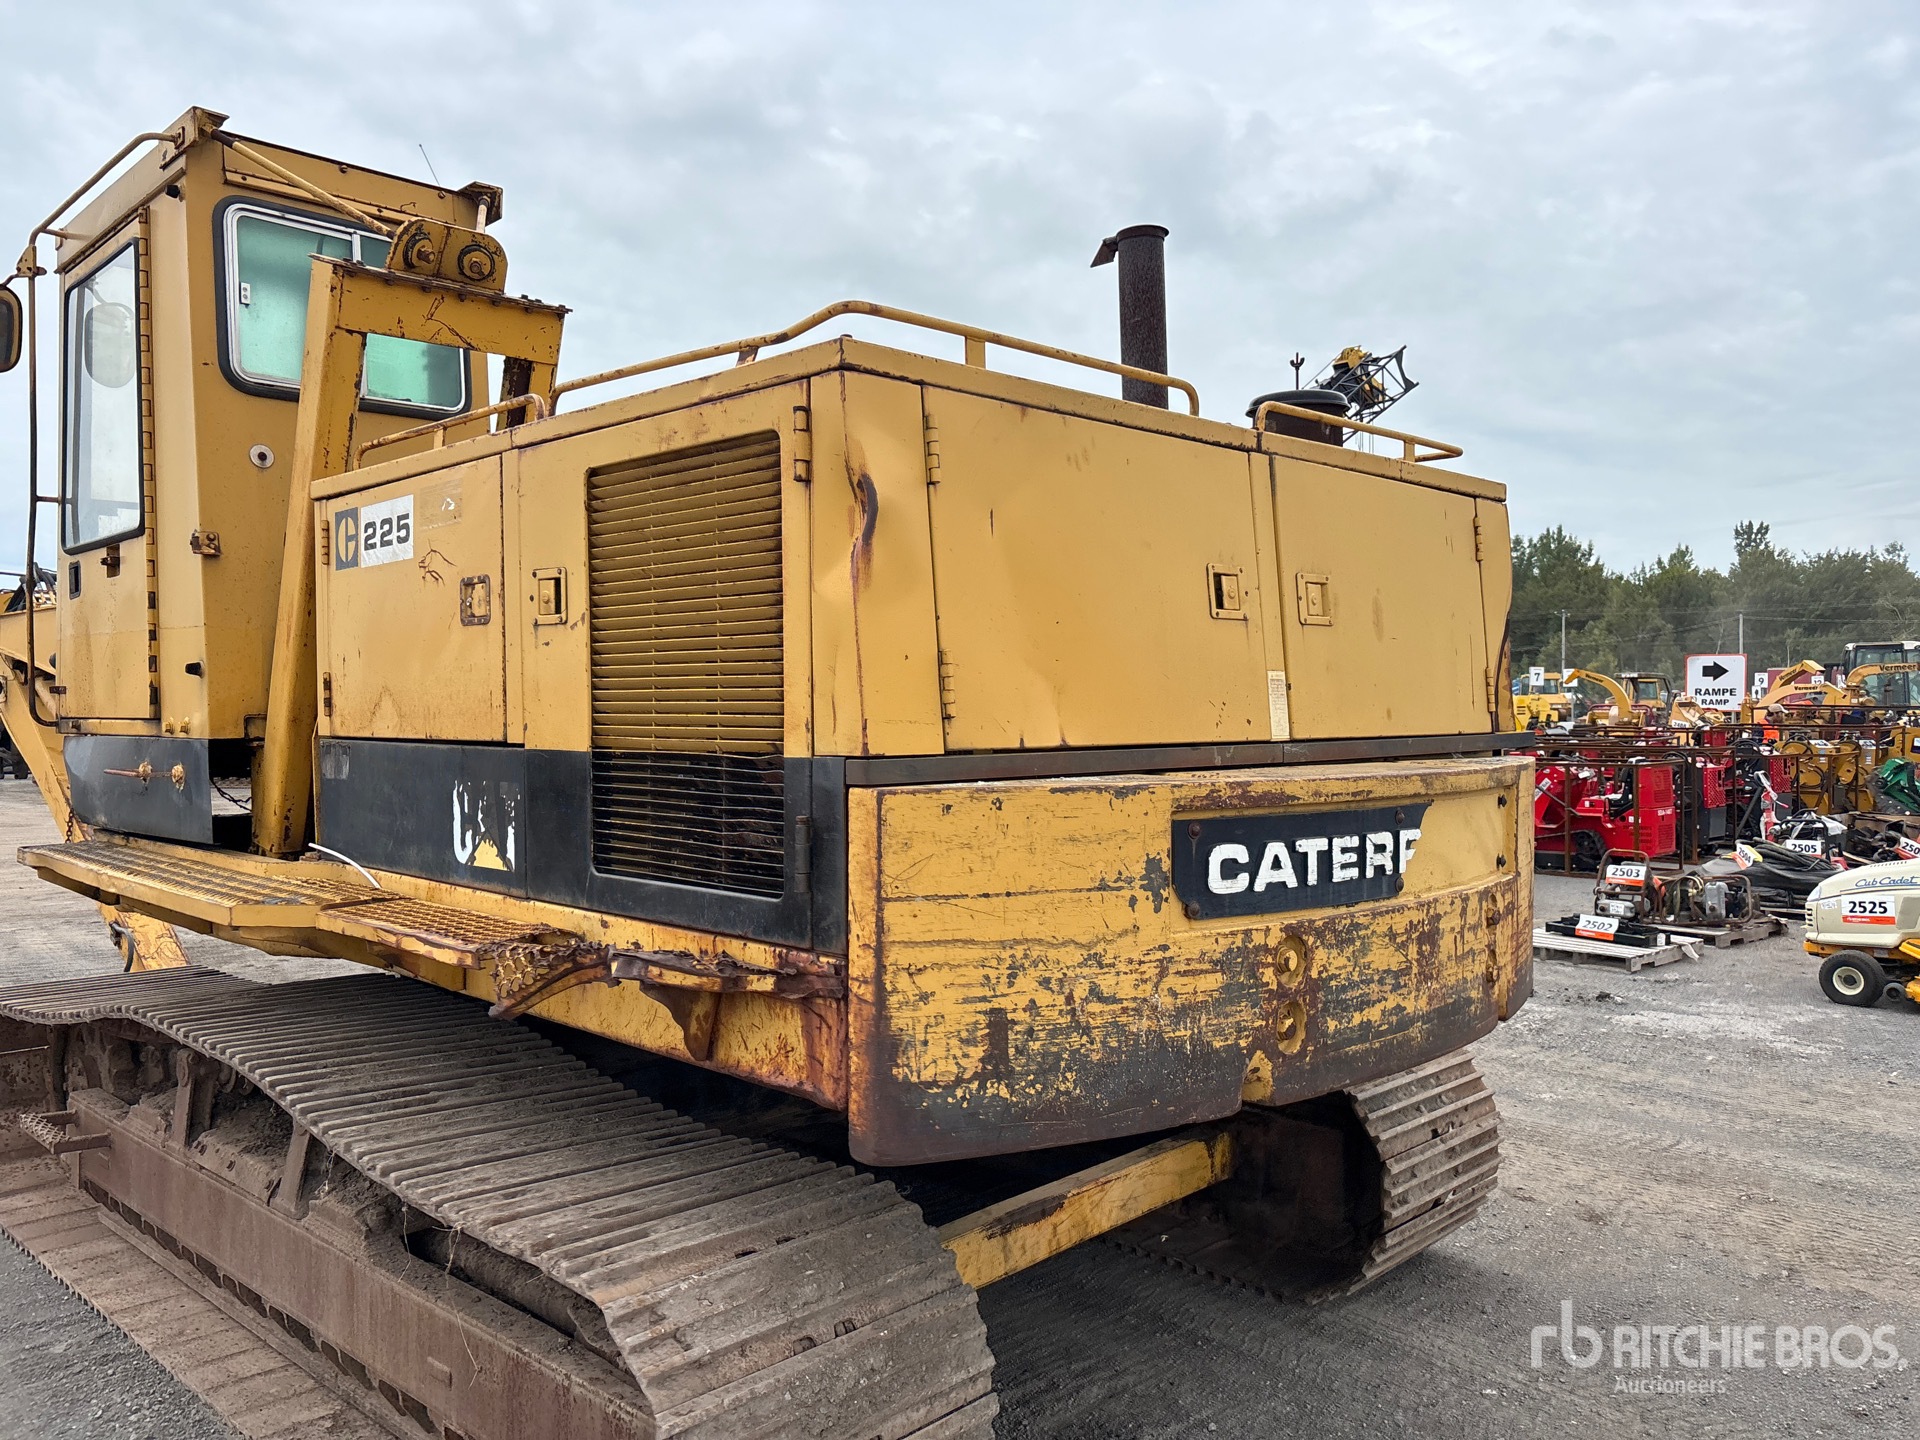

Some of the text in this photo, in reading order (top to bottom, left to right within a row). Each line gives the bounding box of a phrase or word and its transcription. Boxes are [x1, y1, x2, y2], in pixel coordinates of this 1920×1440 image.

[363, 513, 411, 551] 225
[1879, 664, 1918, 672] Vermeer
[1534, 672, 1541, 682] 7
[1778, 668, 1798, 682] Vermeer
[1758, 677, 1765, 685] 9
[1694, 687, 1738, 697] RAMPE
[1701, 698, 1730, 706] RAMP
[1791, 843, 1817, 854] 2505
[1611, 867, 1640, 878] 2503
[1855, 875, 1920, 888] Cub Cadet
[1848, 900, 1888, 915] 2525
[1582, 919, 1613, 932] 2502
